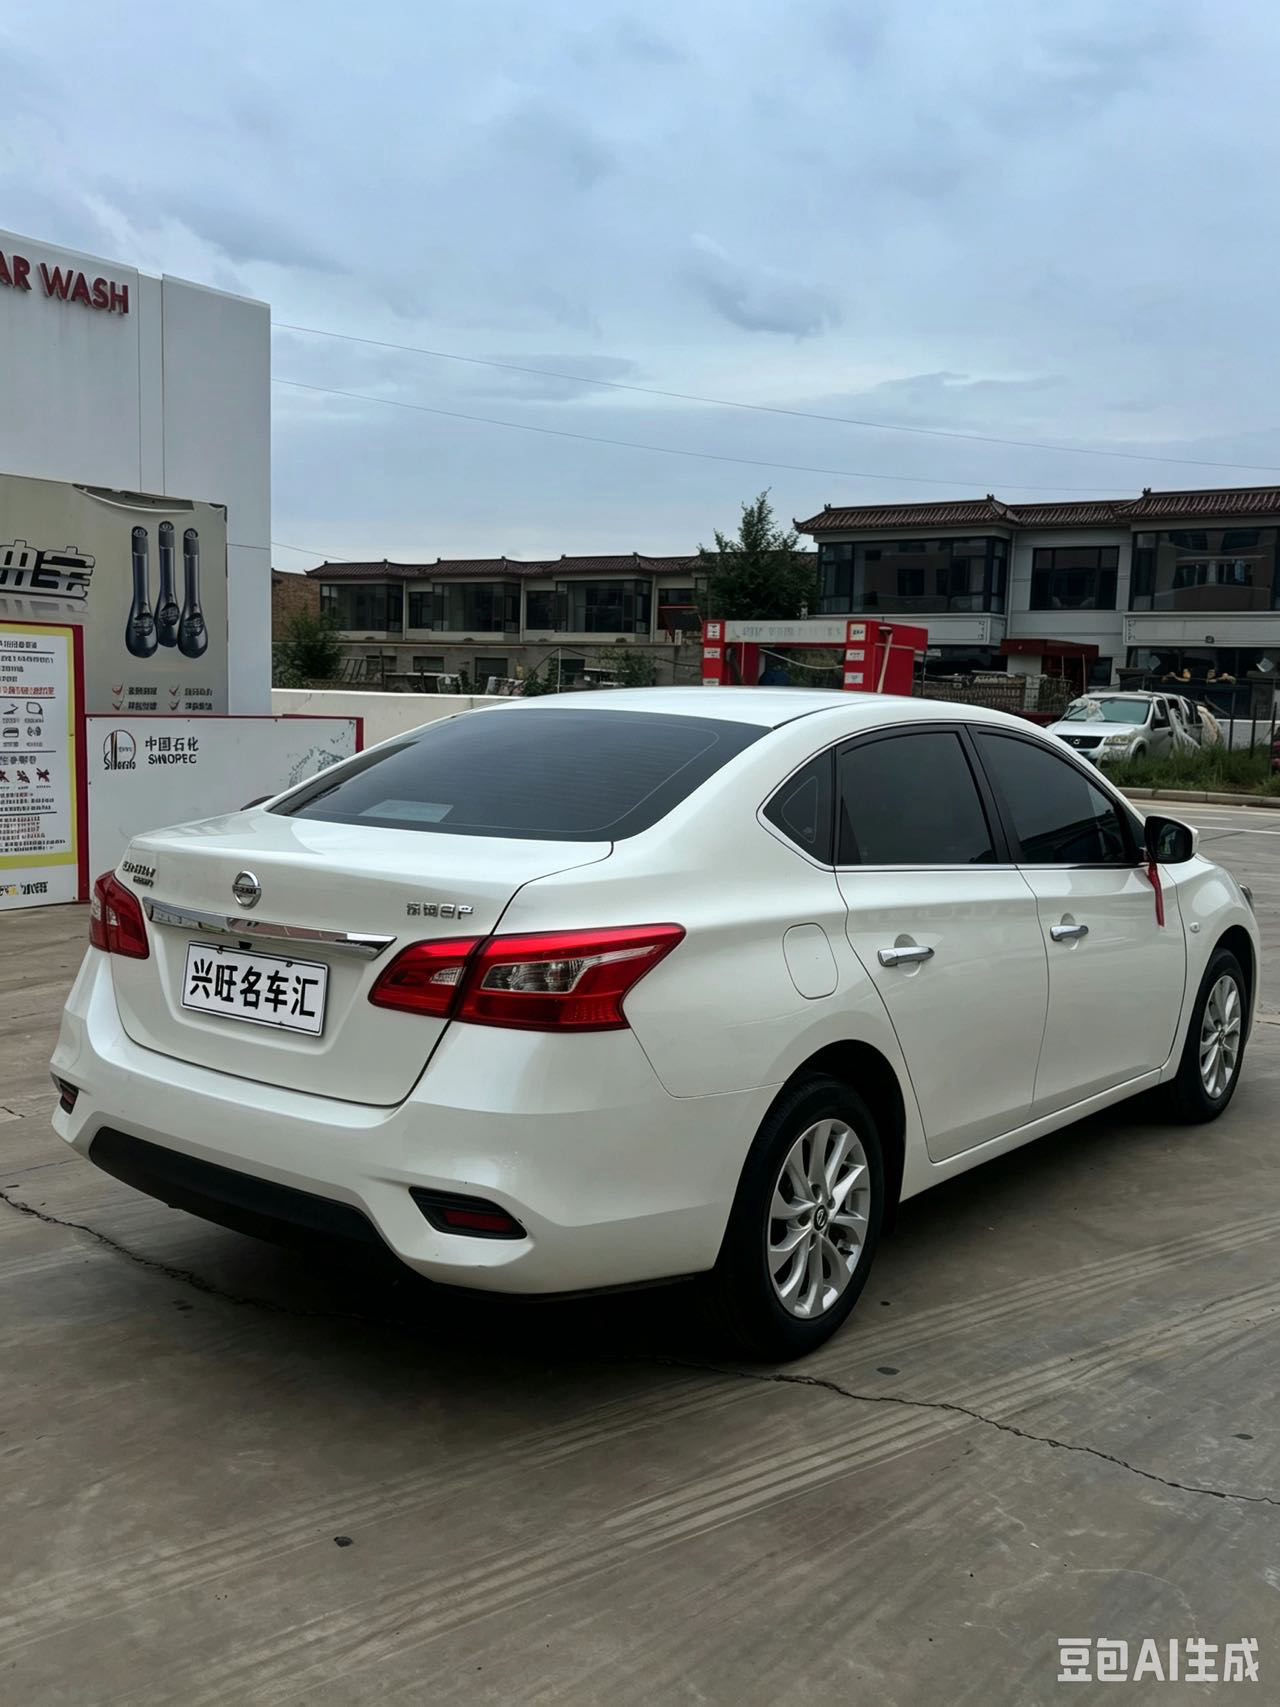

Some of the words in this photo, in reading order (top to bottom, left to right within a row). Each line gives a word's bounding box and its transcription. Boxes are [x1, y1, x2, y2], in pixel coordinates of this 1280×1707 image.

[39, 262, 129, 314] WASH
[145, 736, 199, 752] 中国石化
[147, 753, 198, 765] SINOPEC
[189, 957, 319, 1018] 兴旺名车汇
